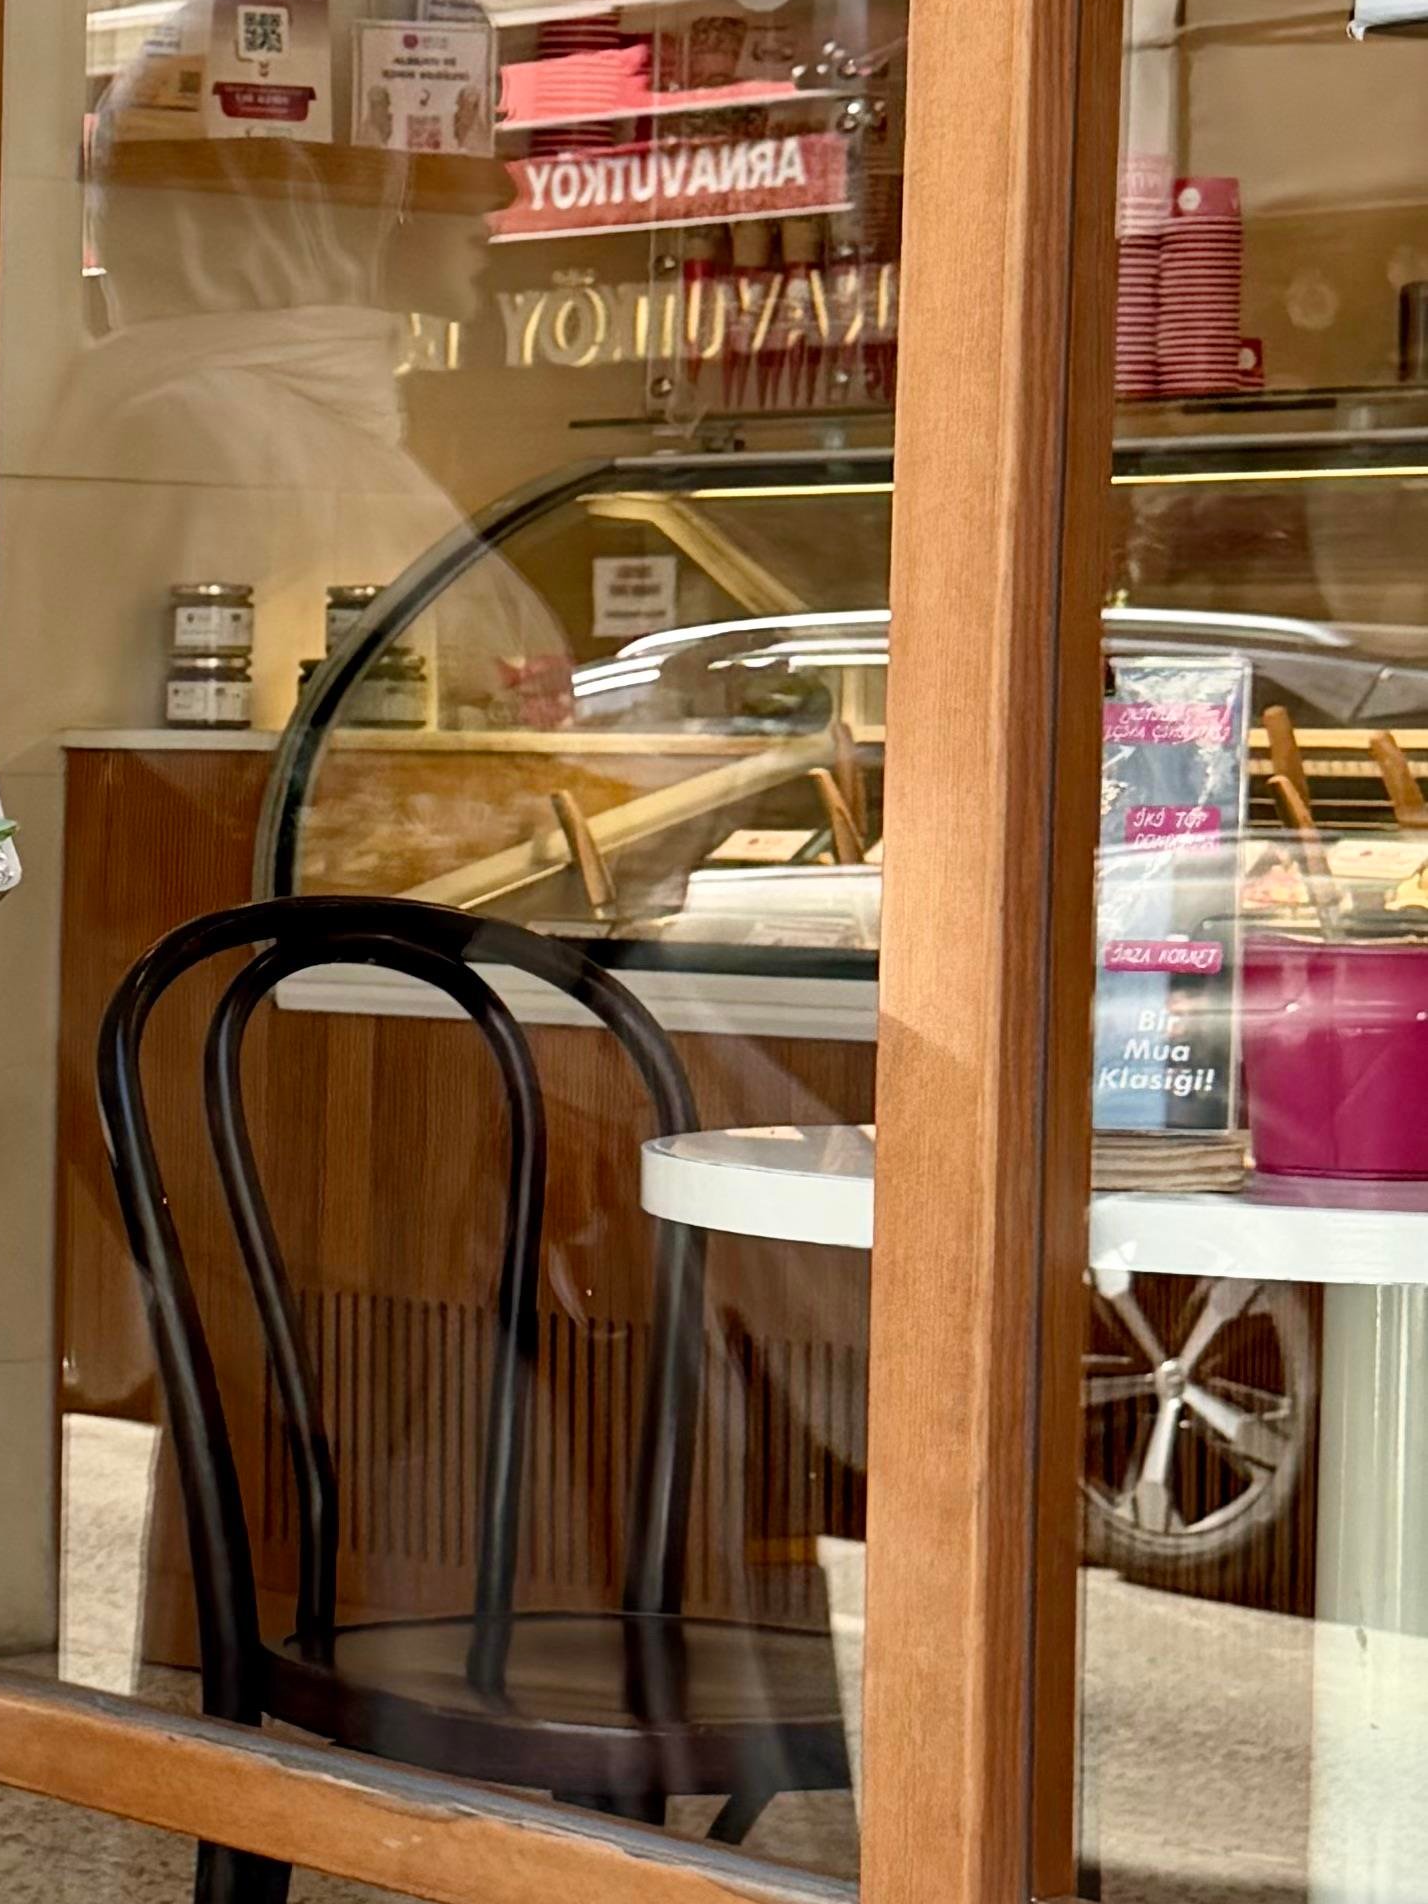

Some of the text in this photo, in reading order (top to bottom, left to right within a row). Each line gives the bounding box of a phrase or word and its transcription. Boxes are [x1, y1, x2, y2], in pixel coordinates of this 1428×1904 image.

[1137, 1008, 1181, 1033] Bir
[1122, 1038, 1192, 1062] Mua
[1097, 1067, 1216, 1097] Klasiği!
